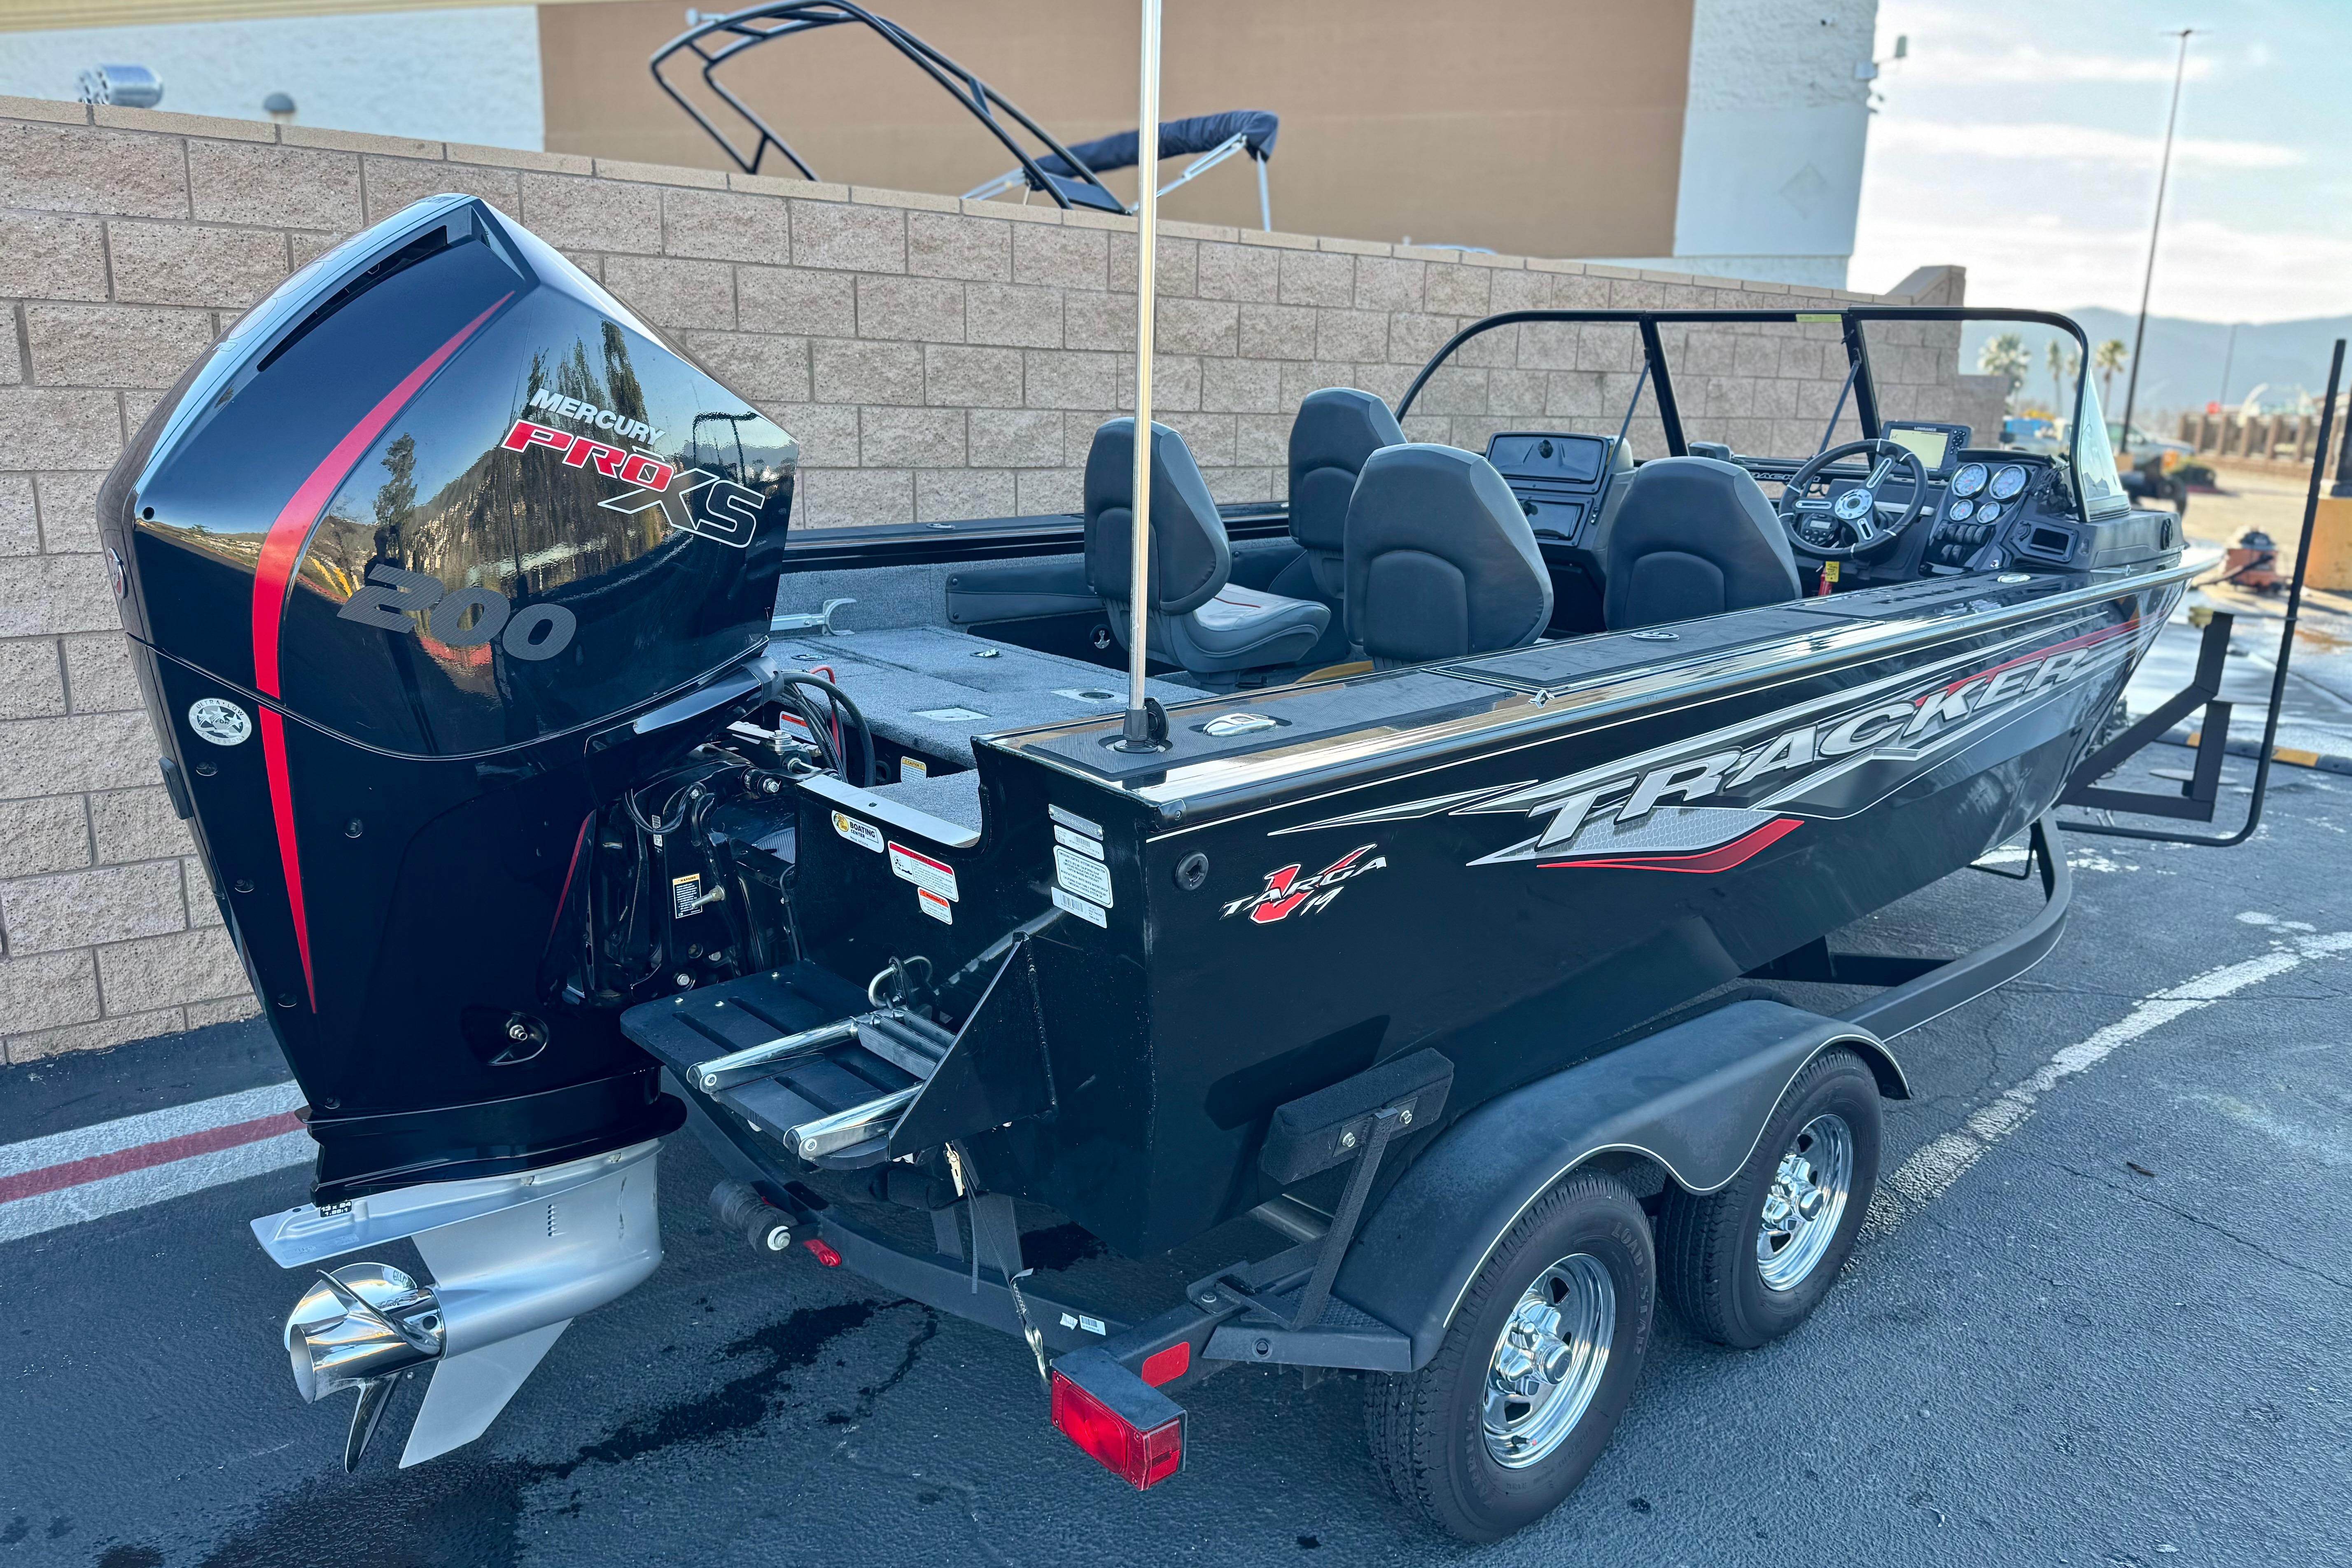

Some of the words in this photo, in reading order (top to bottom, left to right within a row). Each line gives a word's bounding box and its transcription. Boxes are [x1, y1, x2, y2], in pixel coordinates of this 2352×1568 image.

[530, 388, 666, 445] MERCURY
[500, 419, 674, 492] PRO
[597, 468, 765, 548] XS
[336, 563, 576, 660] 200
[196, 700, 220, 709] ULTRA
[227, 703, 244, 716] LOW
[1525, 646, 2089, 852] TRACKER
[850, 821, 875, 838] BOATING
[851, 829, 865, 839] CENTER
[1221, 856, 1387, 918] TARGA
[1299, 885, 1345, 917] 19
[1611, 1222, 1643, 1266] LOAD
[1633, 1285, 1648, 1355] STAR
